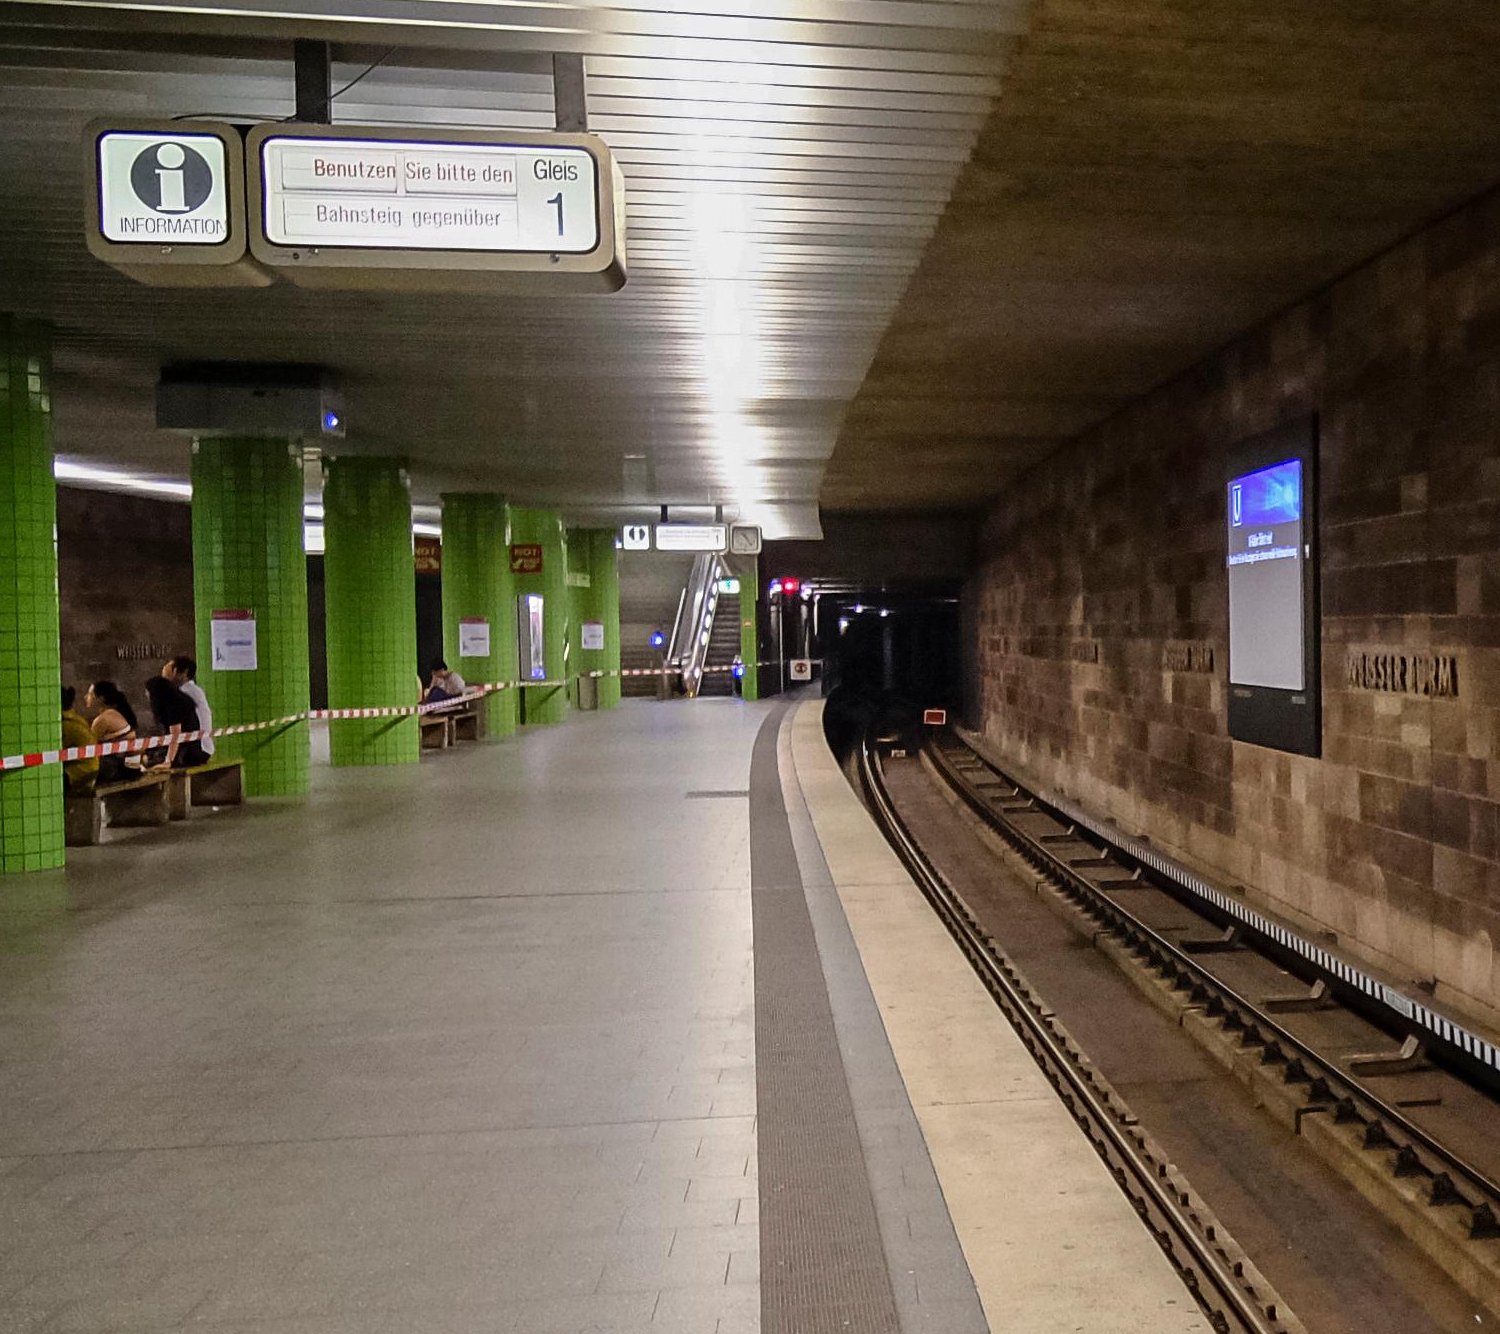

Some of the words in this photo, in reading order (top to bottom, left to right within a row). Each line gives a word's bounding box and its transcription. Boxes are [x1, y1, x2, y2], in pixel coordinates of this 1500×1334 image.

[314, 158, 397, 180] Benutzen
[405, 162, 431, 180] Sie
[436, 163, 476, 183] bitte
[482, 167, 513, 184] den
[533, 158, 579, 182] Gleis
[120, 216, 227, 236] INFORMATION
[316, 204, 402, 229] Bahnsteig
[412, 207, 501, 229] gegenüber
[547, 192, 564, 236] 1
